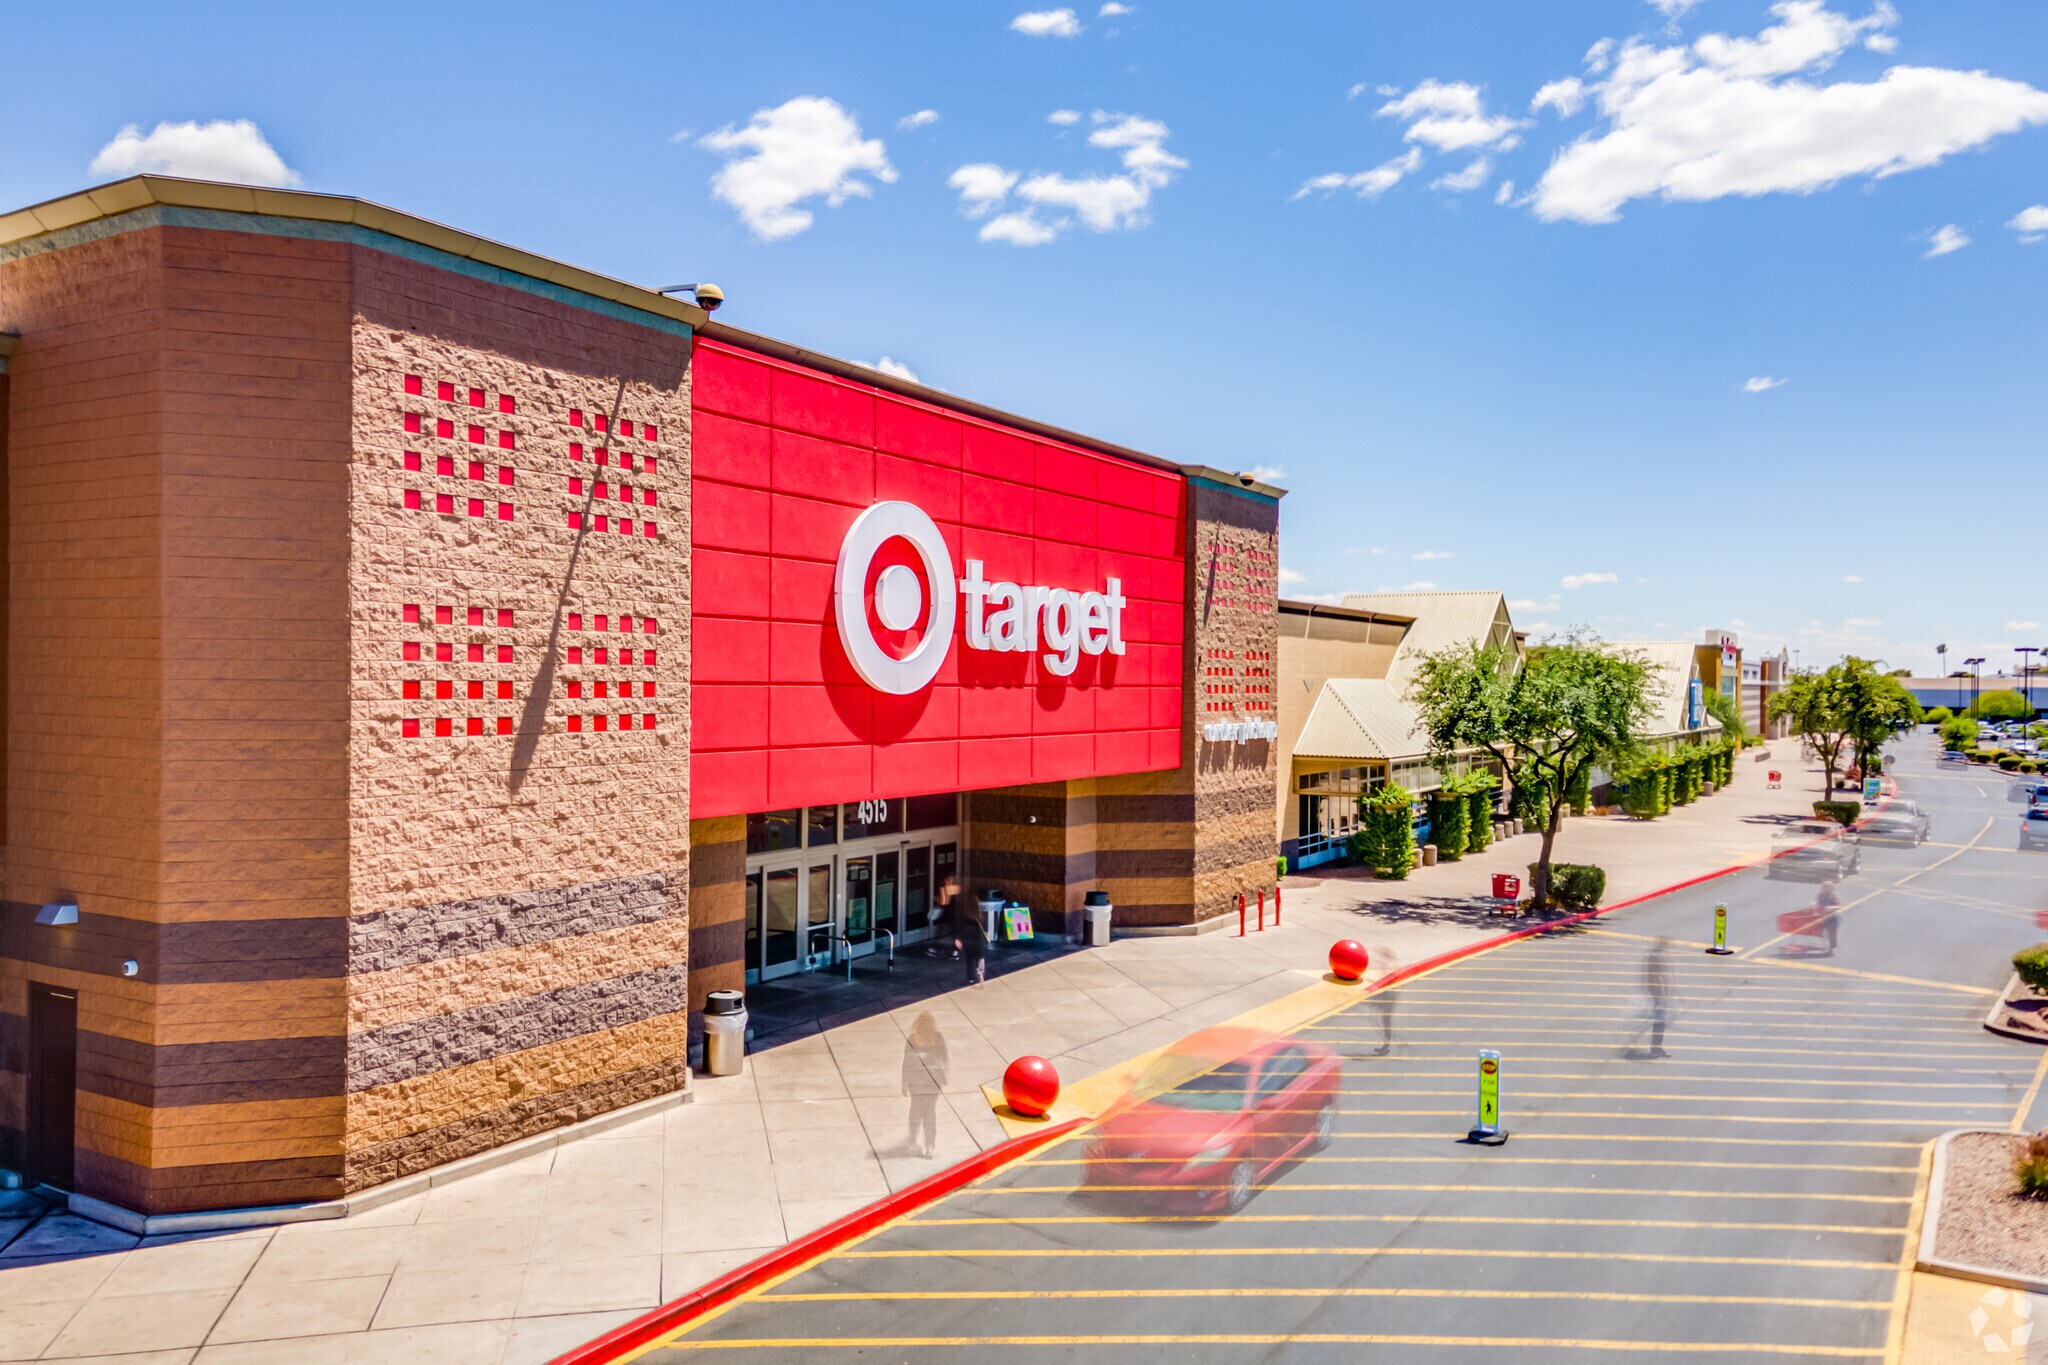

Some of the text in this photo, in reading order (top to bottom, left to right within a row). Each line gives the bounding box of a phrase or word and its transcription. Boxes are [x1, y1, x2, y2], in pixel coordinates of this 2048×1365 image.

[960, 560, 1126, 676] target
[1204, 717, 1277, 745] order pickup
[858, 799, 887, 825] 4515
[1482, 1063, 1496, 1071] STOP
